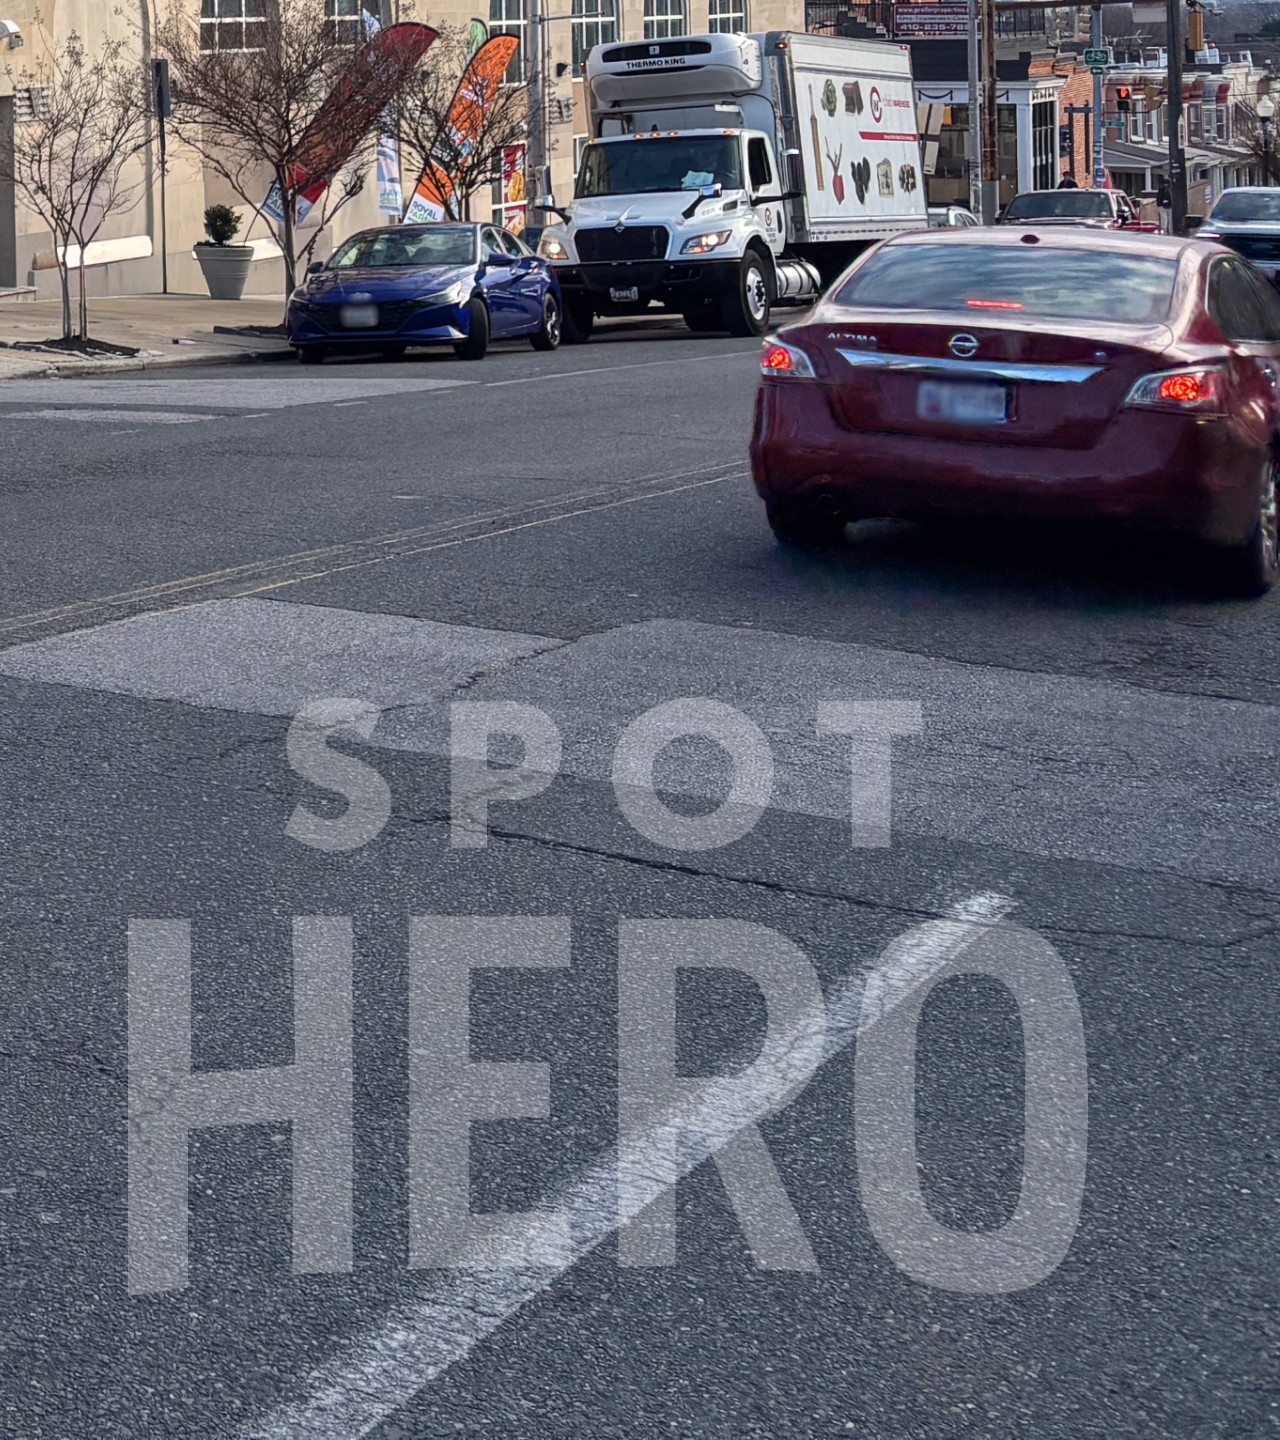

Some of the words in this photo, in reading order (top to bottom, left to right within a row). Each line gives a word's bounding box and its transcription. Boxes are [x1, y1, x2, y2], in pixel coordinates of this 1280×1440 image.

[626, 60, 663, 69] THERMO
[665, 58, 686, 66] KING
[412, 201, 438, 220] ROYAL
[828, 332, 878, 341] ALTIMA
